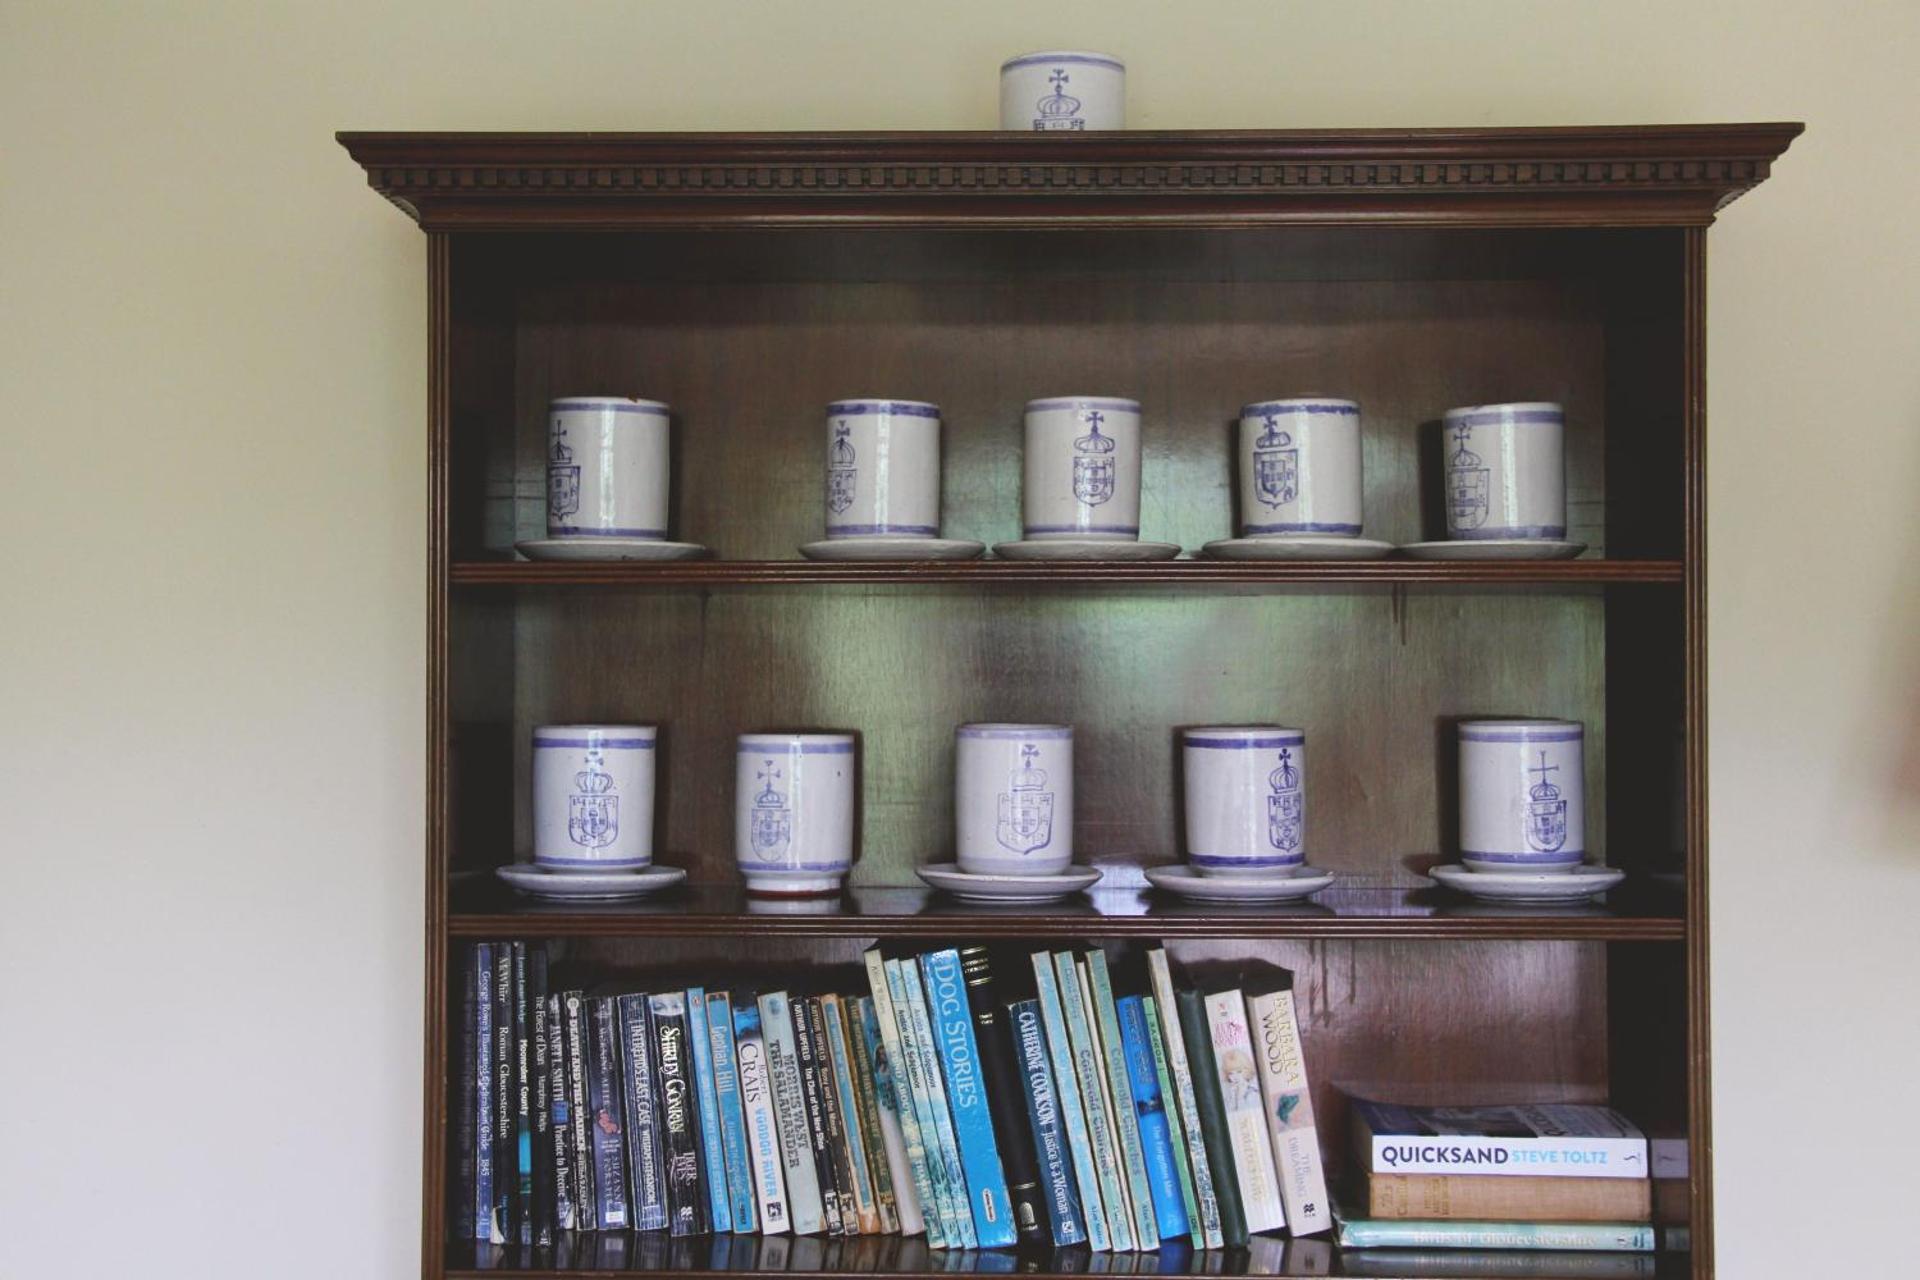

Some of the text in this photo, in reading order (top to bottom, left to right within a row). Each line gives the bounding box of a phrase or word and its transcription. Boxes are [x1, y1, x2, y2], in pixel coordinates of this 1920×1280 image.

[480, 971, 491, 1000] George
[499, 957, 509, 1002] McWhirr
[481, 1003, 491, 1031] Rowe's
[536, 996, 545, 1009] The
[536, 1011, 546, 1033] Forest
[794, 1004, 811, 1061] ARTHUR UPFIELD
[933, 964, 979, 1108] DOG STORIES
[537, 1044, 547, 1065] Dean
[550, 1024, 562, 1057] JANET
[815, 1033, 826, 1061] UPFIELD
[1263, 1012, 1284, 1075] WOOD
[1276, 995, 1301, 1085] BARBARA
[711, 1026, 733, 1093] Gentian Hill
[741, 1043, 761, 1104] CRAIS
[805, 1066, 814, 1080] The
[1019, 1011, 1057, 1126] CATHERINE COOKSON
[499, 1026, 510, 1138] Roman Gloucestershire
[519, 1040, 529, 1115] Moonraker County
[552, 1068, 564, 1101] SMITH
[570, 1021, 585, 1151] DEATH AND THE MAIDEN
[636, 1077, 650, 1101] LAST
[659, 1026, 687, 1133] SHIRLEY CONRAN
[758, 1064, 769, 1095] Robert
[824, 1086, 833, 1099] and
[1080, 1049, 1101, 1111] Cotswold
[637, 1102, 651, 1126] CASE
[770, 1040, 800, 1169] THE SALAMANDER
[783, 1053, 810, 1149] MORRIS WEST
[811, 1105, 820, 1116] the
[826, 1100, 835, 1111] the
[1111, 1047, 1141, 1176] Cotswold Churches
[481, 1126, 491, 1150] Guide
[814, 1117, 824, 1132] New
[816, 1132, 825, 1150] Shoe
[1152, 1126, 1163, 1139] The
[481, 1159, 490, 1175] 1845
[555, 1125, 569, 1197] Practice to Deceive
[756, 1107, 778, 1197] VOODOO RIVER
[1382, 1146, 1608, 1167] QUICKSAND STEVE TOLTZ
[1042, 1129, 1060, 1160] Justice
[1053, 1177, 1069, 1214] Woman
